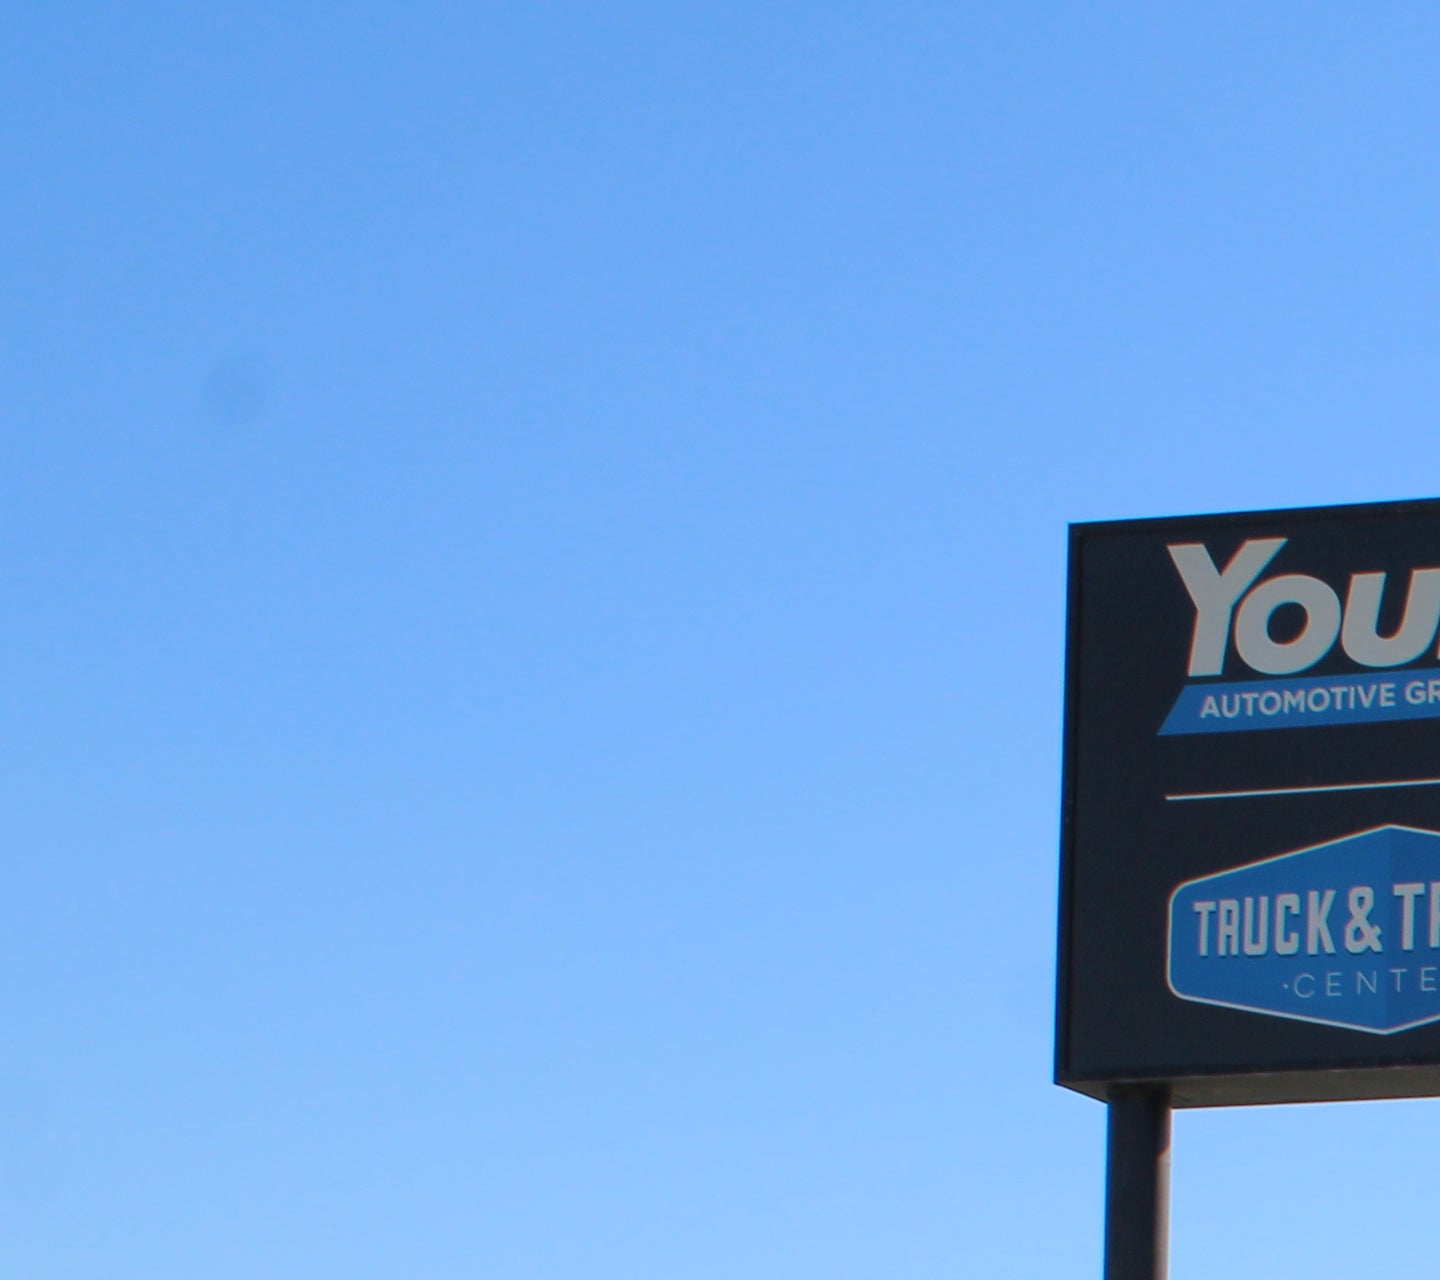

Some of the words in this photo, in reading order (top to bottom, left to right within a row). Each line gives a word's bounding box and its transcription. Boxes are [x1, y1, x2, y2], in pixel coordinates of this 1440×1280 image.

[1200, 683, 1396, 719] AUTOMOTIVE
[1194, 889, 1337, 957] TRUCK
[1344, 885, 1384, 954] &
